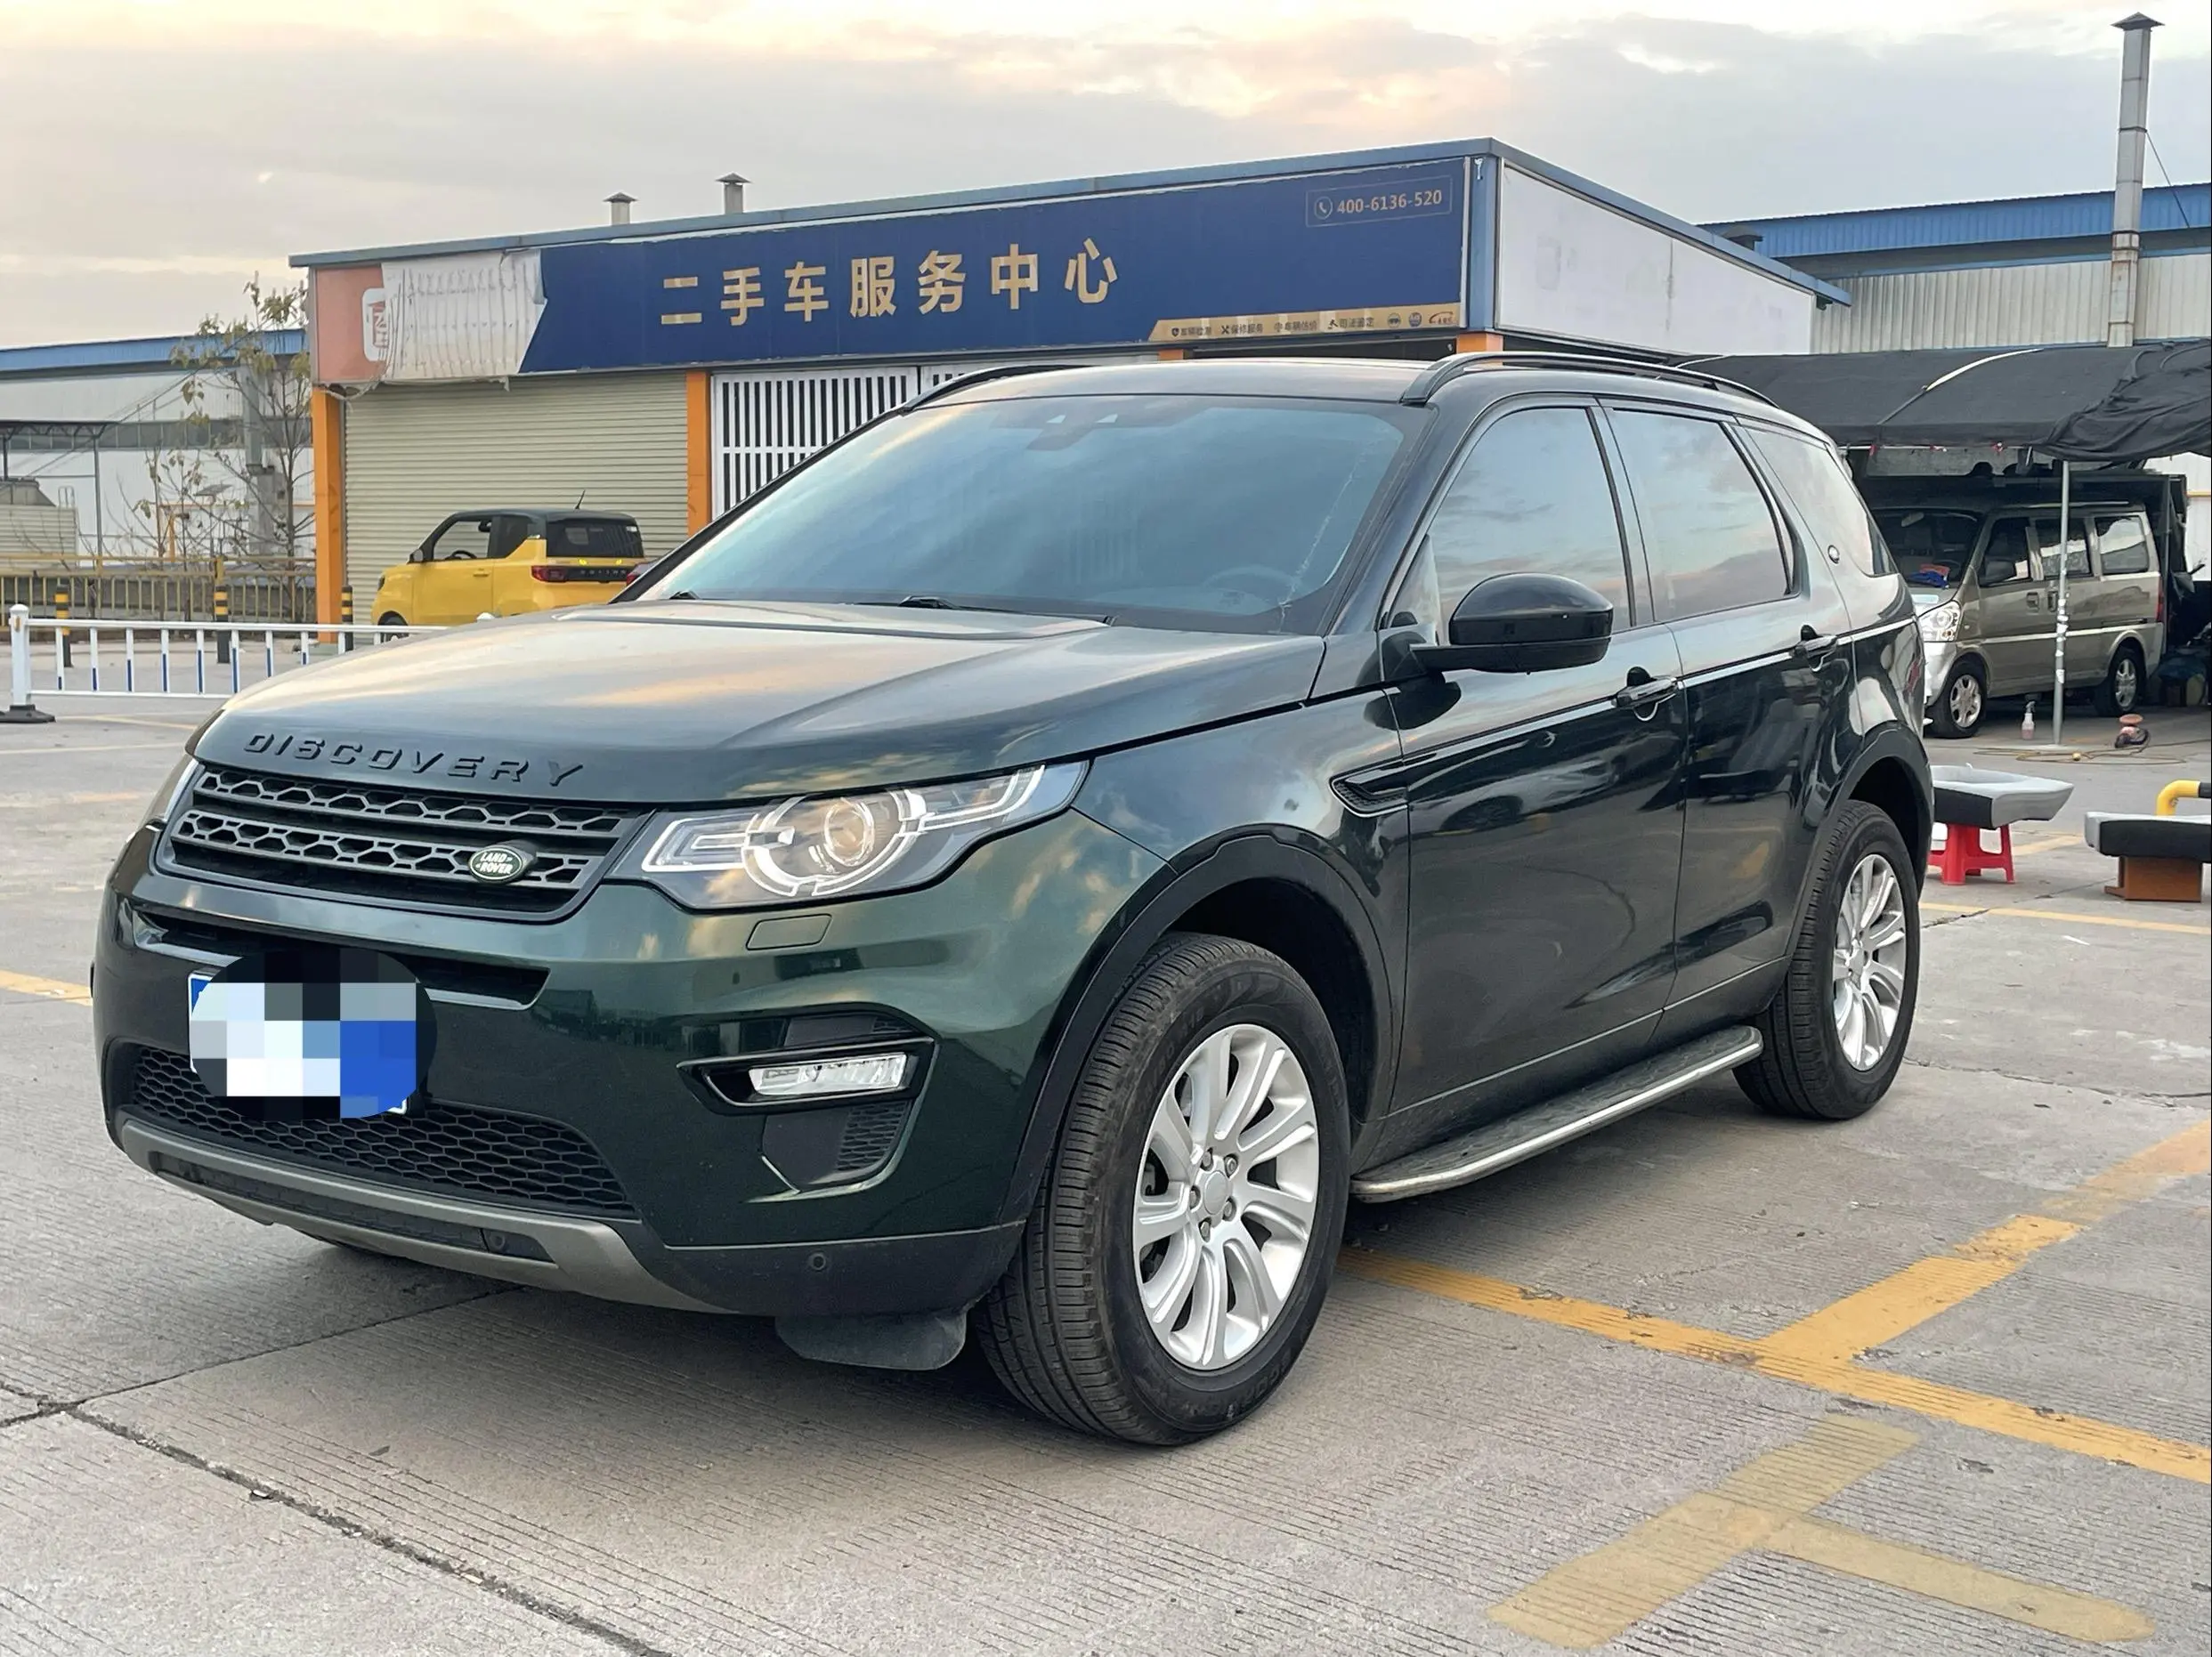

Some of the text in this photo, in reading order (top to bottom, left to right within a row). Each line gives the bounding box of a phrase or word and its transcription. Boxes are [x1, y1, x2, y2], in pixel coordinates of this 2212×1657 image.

[1337, 190, 1442, 214] 400-6136-520
[660, 237, 1118, 327] 二手车服务中心
[244, 733, 584, 788] DISCOVERY
[479, 861, 514, 875] ROVER
[480, 852, 507, 863] LAND
